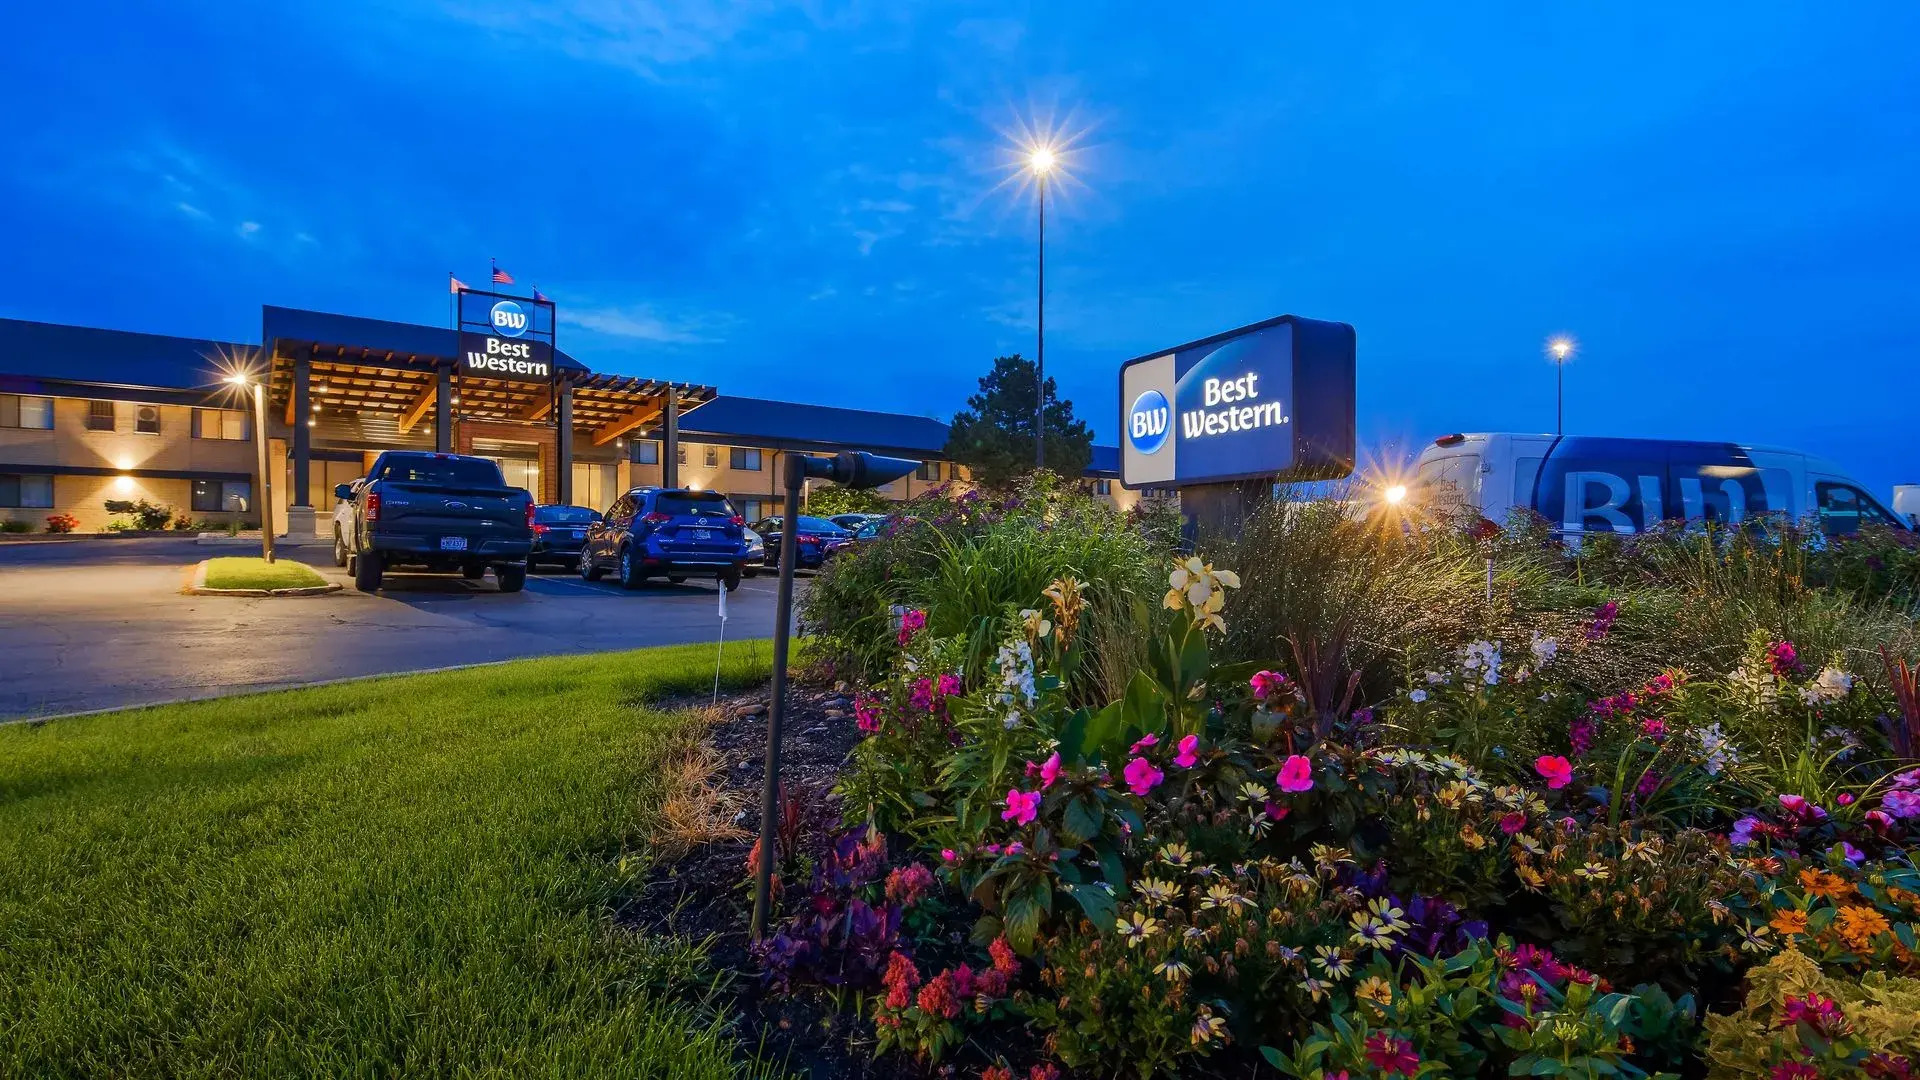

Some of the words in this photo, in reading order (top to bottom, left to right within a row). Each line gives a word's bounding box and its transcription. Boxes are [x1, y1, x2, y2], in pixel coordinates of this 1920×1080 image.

[494, 310, 526, 328] BW
[486, 338, 530, 358] Best
[467, 352, 548, 376] Western
[1204, 372, 1259, 406] Best
[1132, 408, 1168, 439] BW
